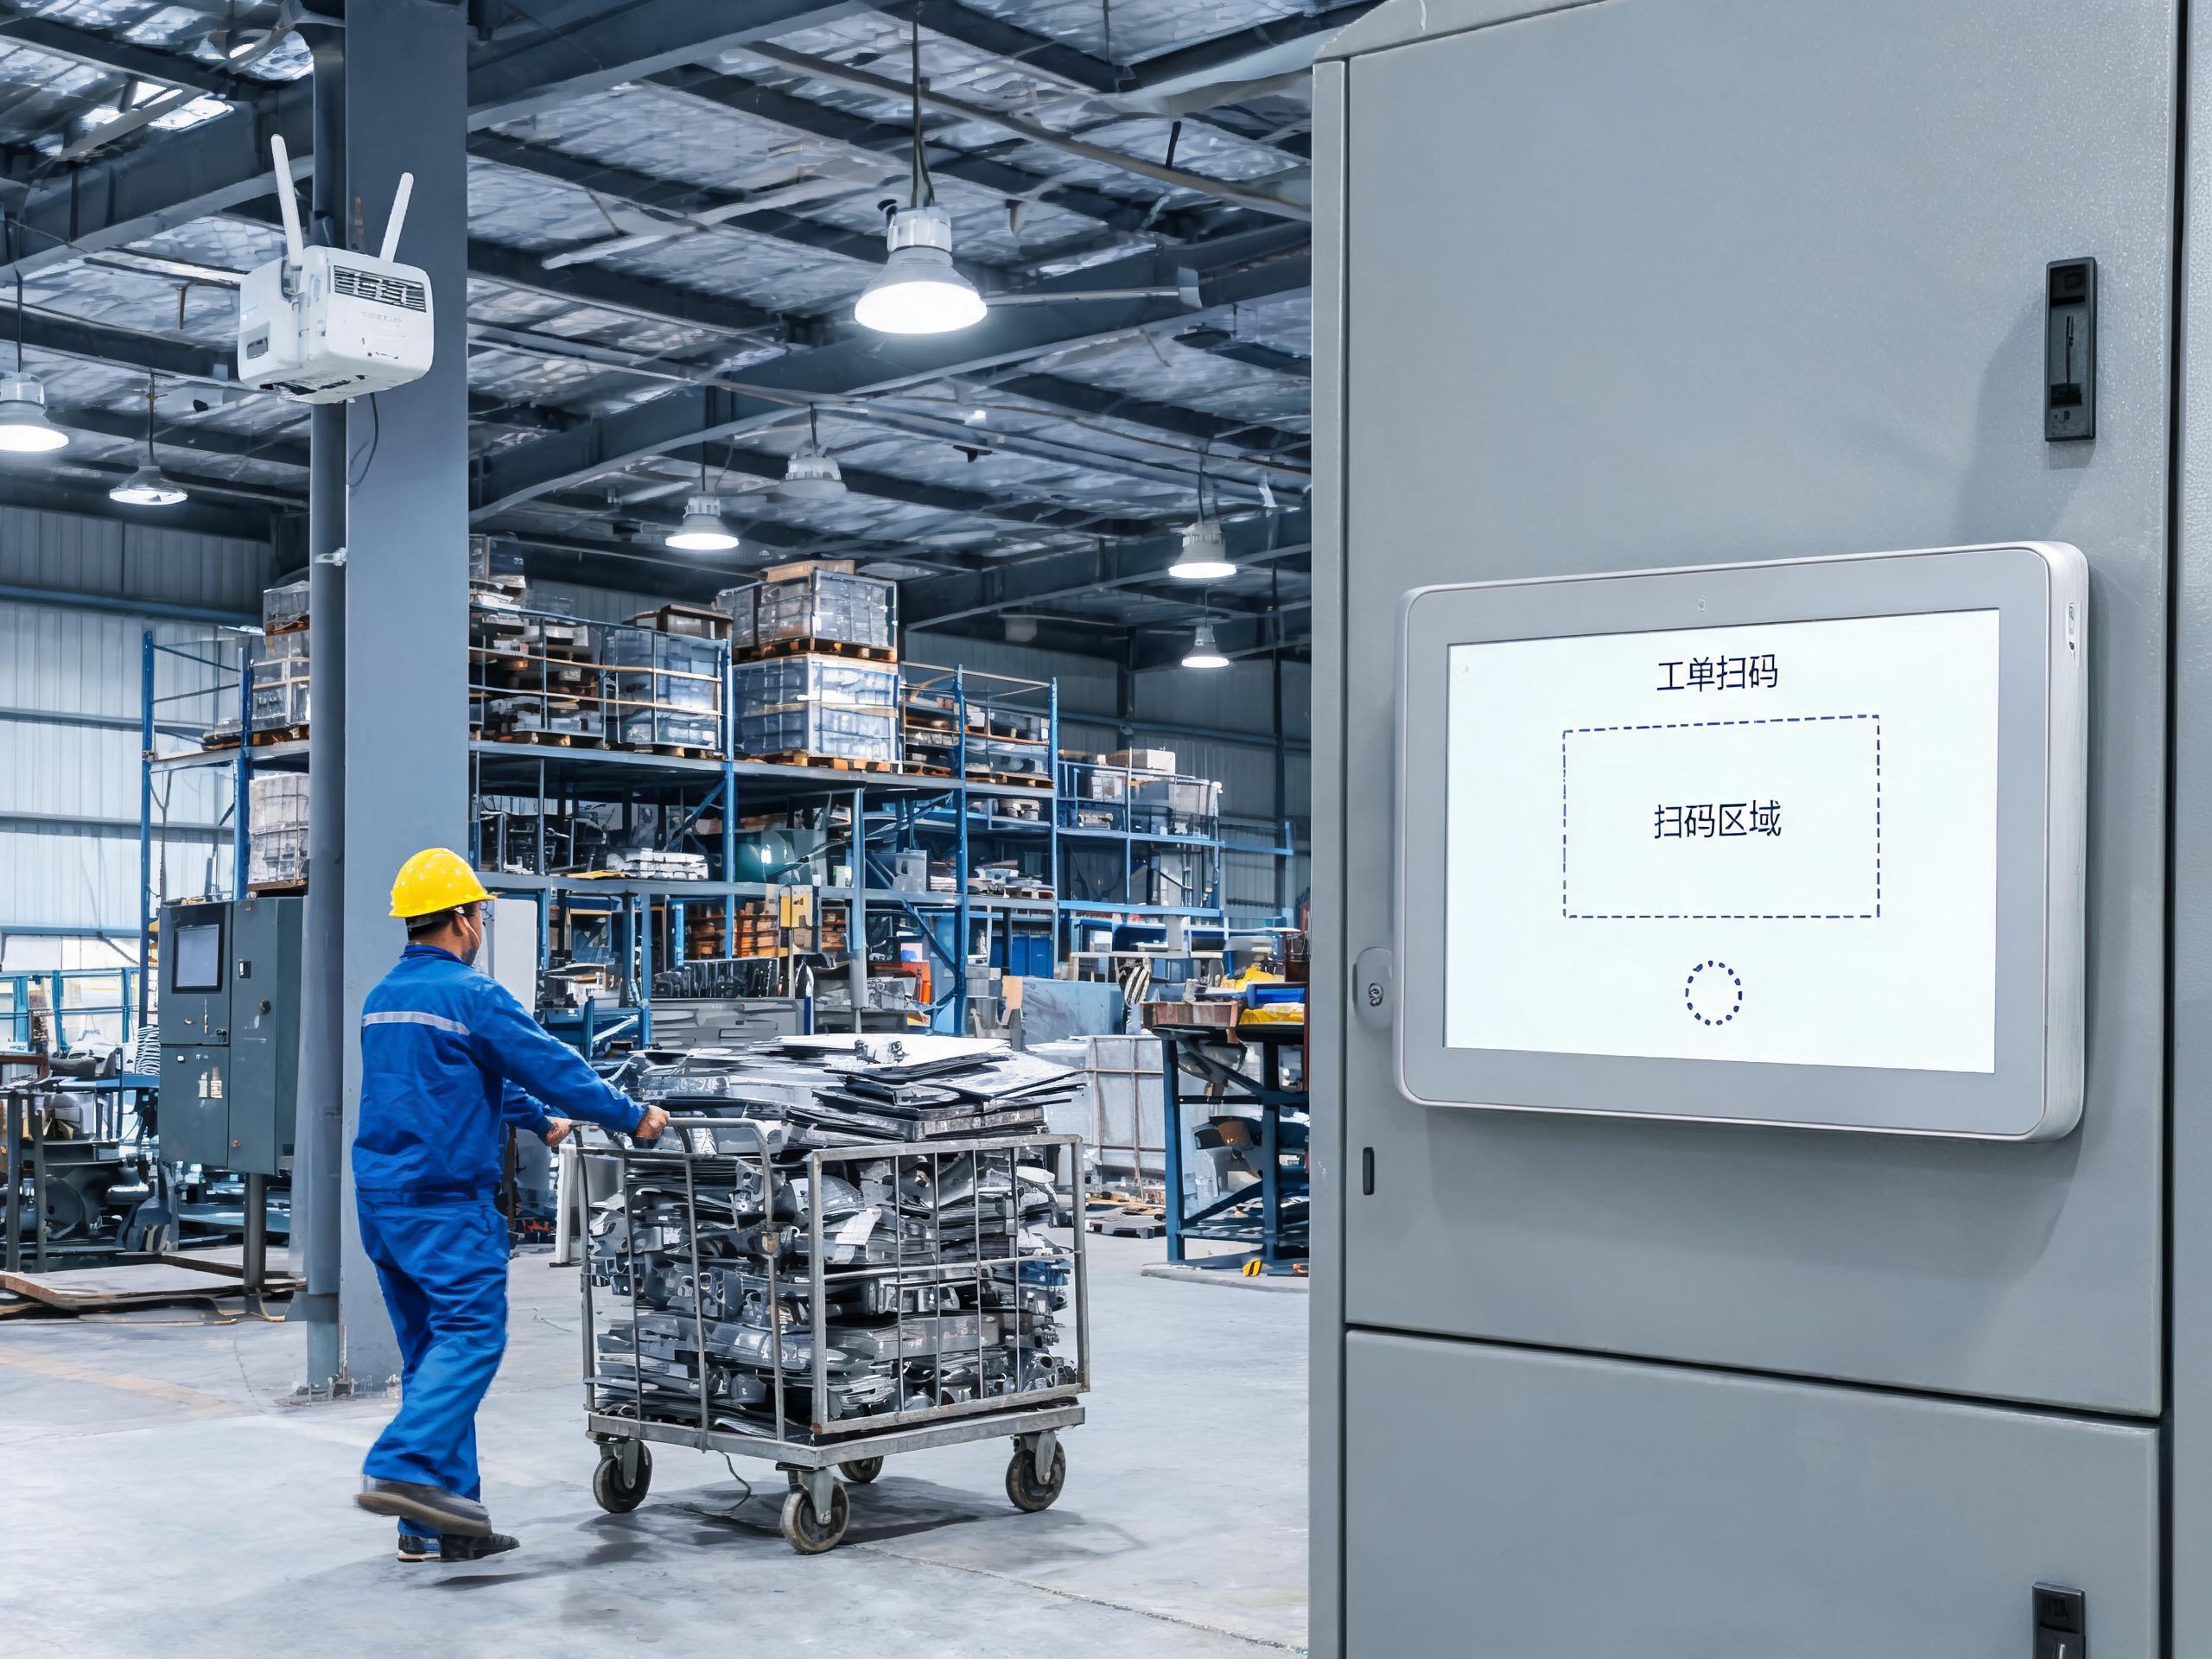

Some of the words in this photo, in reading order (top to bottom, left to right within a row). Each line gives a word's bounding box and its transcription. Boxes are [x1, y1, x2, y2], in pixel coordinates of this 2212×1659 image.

[1656, 653, 1778, 693] 工单扫码
[1654, 799, 1782, 840] 扫码区域
